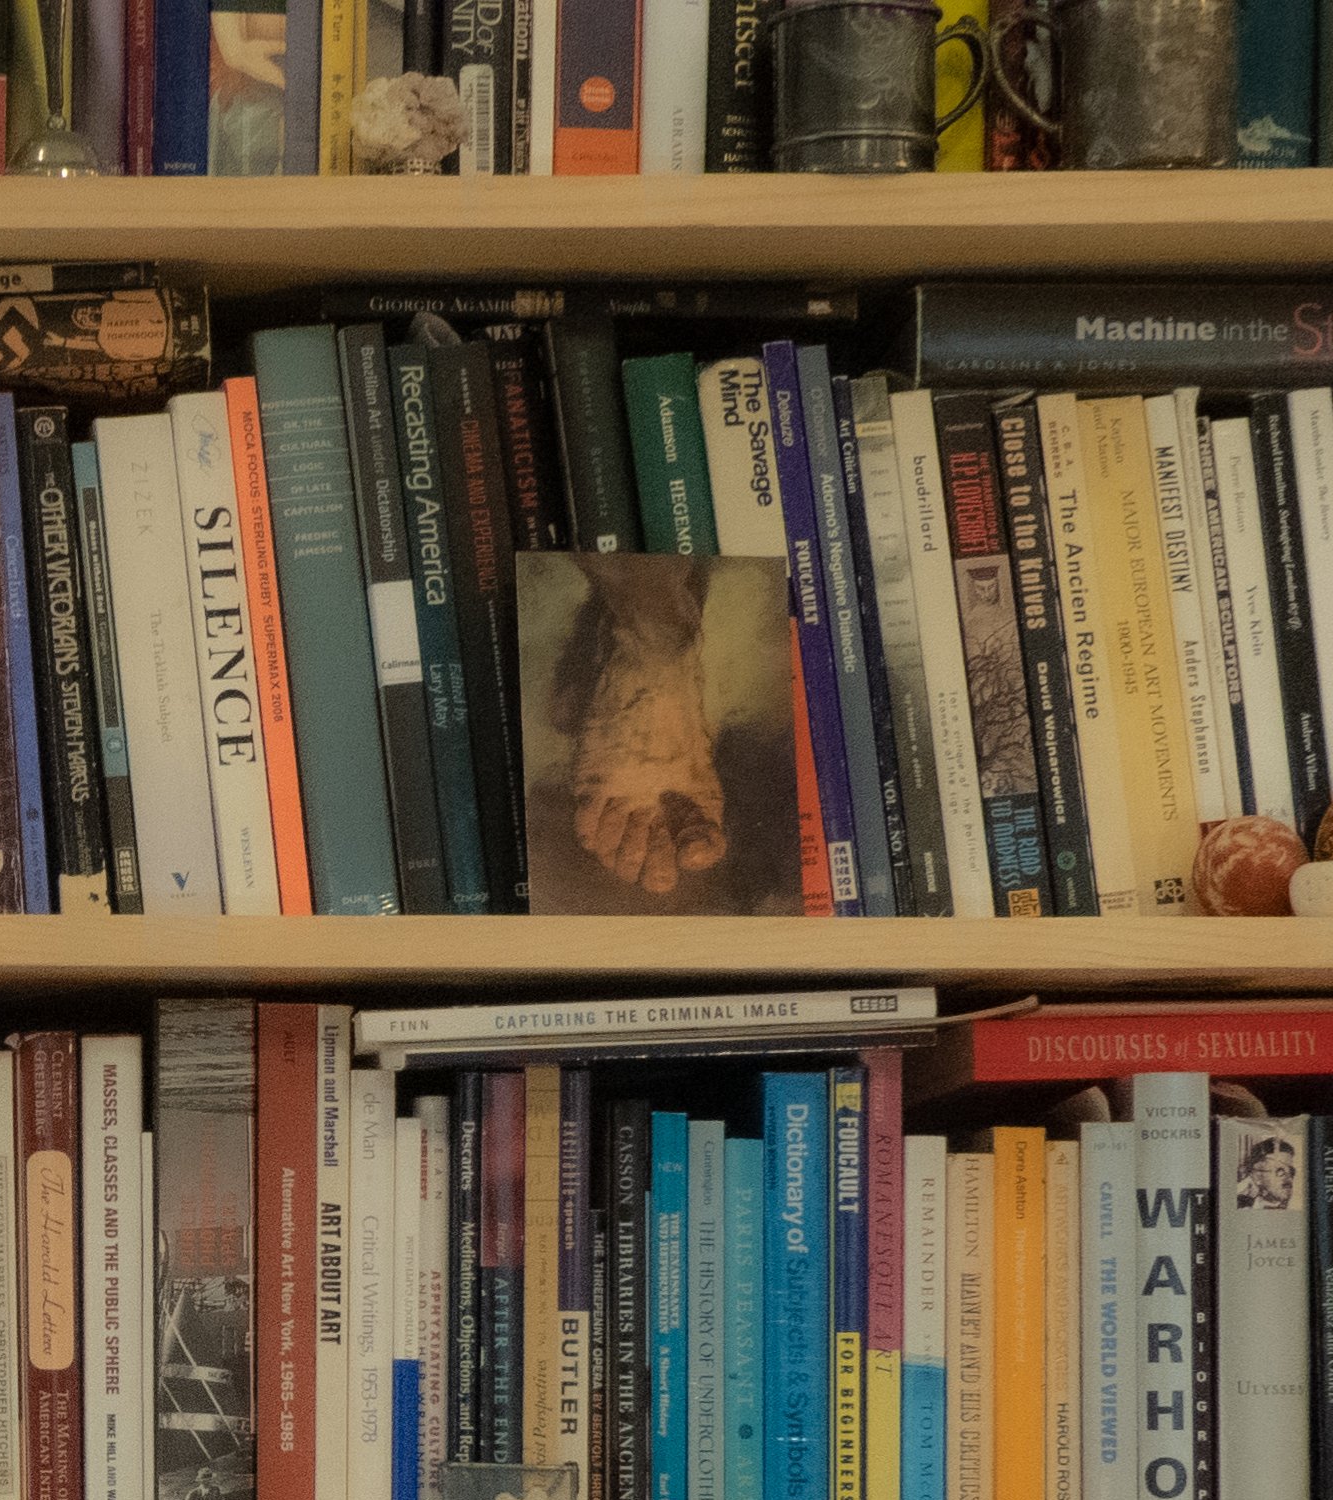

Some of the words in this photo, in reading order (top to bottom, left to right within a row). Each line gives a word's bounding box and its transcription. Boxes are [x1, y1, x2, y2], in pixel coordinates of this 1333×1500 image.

[1076, 316, 1215, 341] Machine
[1223, 318, 1240, 341] in
[1252, 318, 1288, 341] the
[721, 370, 743, 427] Mind
[744, 370, 761, 412] The
[398, 365, 436, 491] Recasting
[1002, 417, 1030, 478] Close
[746, 421, 774, 506] Savage
[913, 456, 938, 553] baudrillard
[1009, 485, 1033, 507] to
[1058, 490, 1080, 535] The
[415, 497, 447, 605] America
[1012, 513, 1039, 549] the
[1020, 558, 1047, 629] Knives
[1064, 542, 1090, 624] Ancien
[194, 506, 256, 767] SILENCE
[390, 1020, 429, 1032] FINN
[494, 1011, 598, 1031] CAPTURING
[605, 1009, 638, 1024] THE
[647, 1004, 734, 1023] CRIMINAL
[743, 1002, 799, 1018] IMAGE
[1028, 1033, 1168, 1062] DISCOURSES
[1174, 1035, 1190, 1057] of
[1198, 1031, 1317, 1059] SEXUALITY
[782, 1104, 809, 1224] Dictionary
[836, 1117, 860, 1214] FOUCAULT
[320, 1202, 341, 1236] ART
[786, 1230, 809, 1253] of
[320, 1244, 341, 1302] ABOUT
[320, 1309, 341, 1345] ART
[780, 1259, 810, 1365] Subjects
[560, 1318, 580, 1435] BUTLER
[786, 1372, 808, 1387] &
[838, 1338, 856, 1377] FOR
[782, 1393, 809, 1496] Symbols
